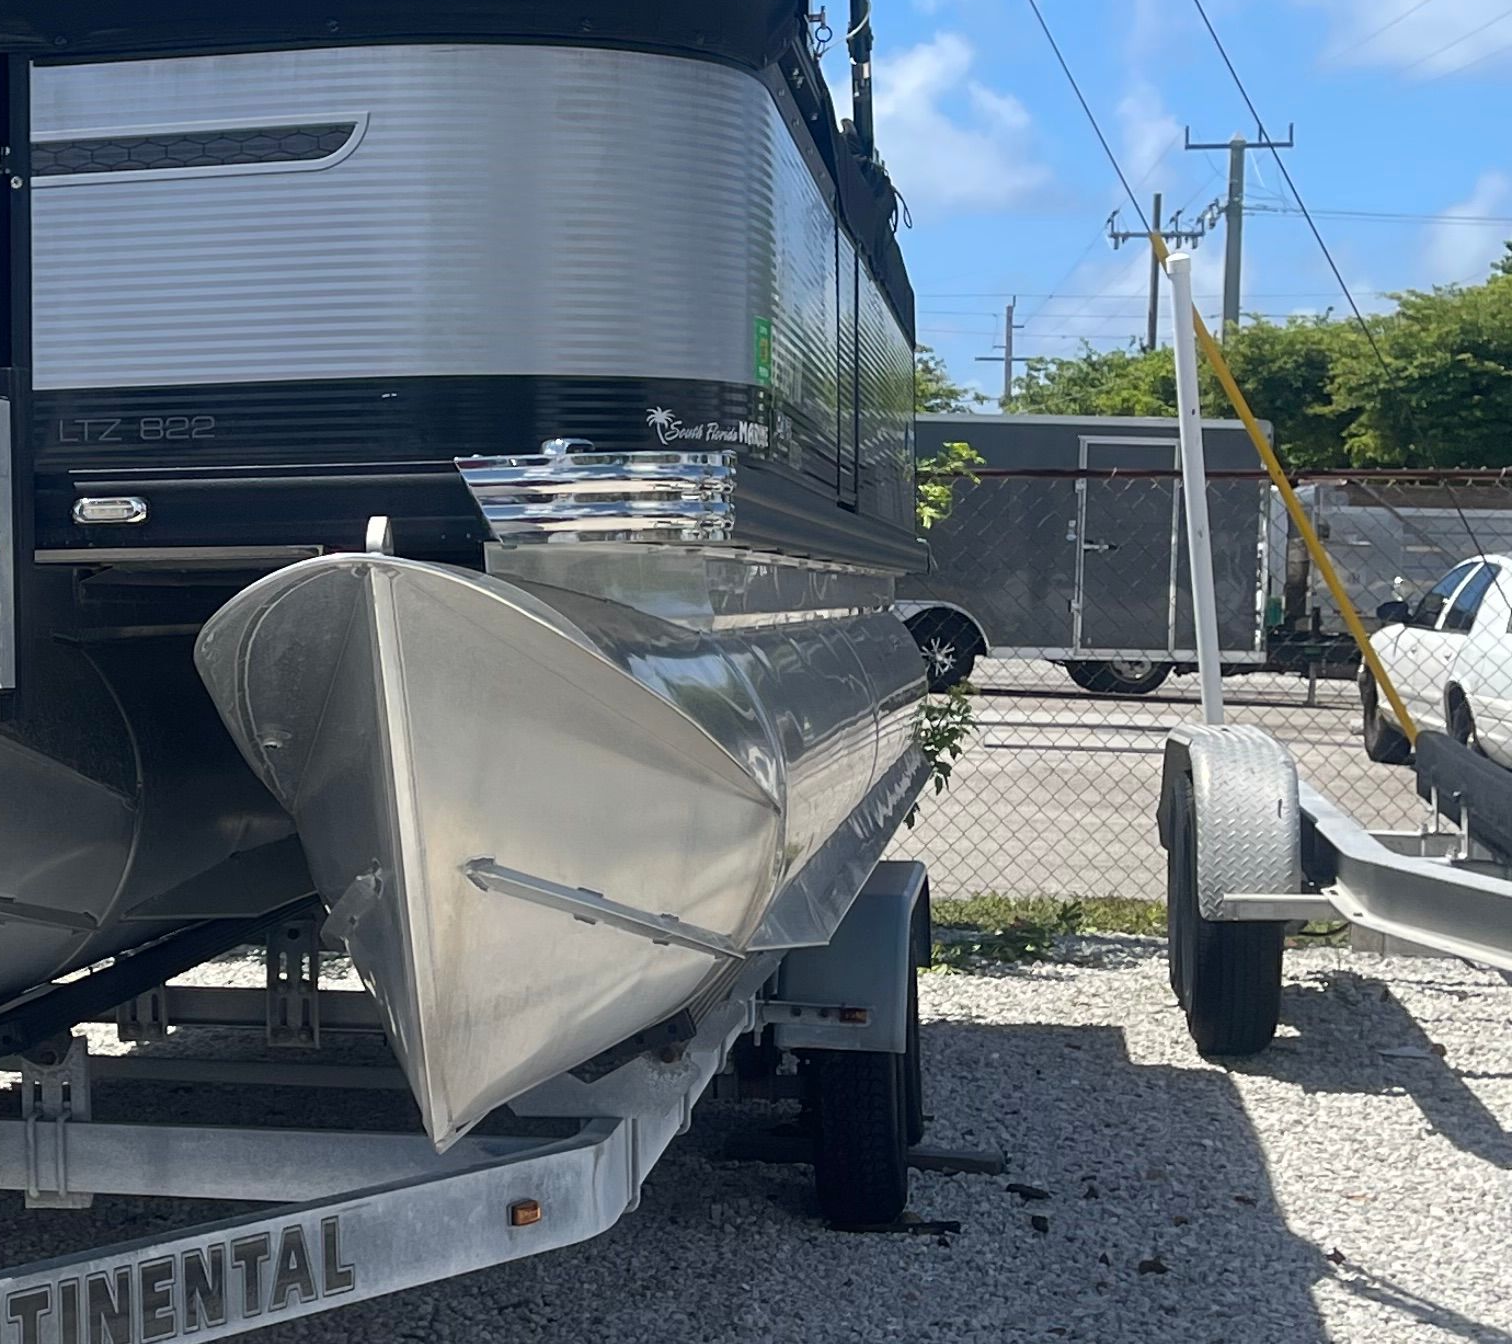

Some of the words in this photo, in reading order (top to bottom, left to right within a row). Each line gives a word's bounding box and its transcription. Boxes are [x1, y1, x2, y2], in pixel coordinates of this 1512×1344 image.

[58, 417, 123, 443] LTZ
[139, 415, 216, 441] 822
[665, 420, 703, 442] South
[705, 421, 738, 442] Florida
